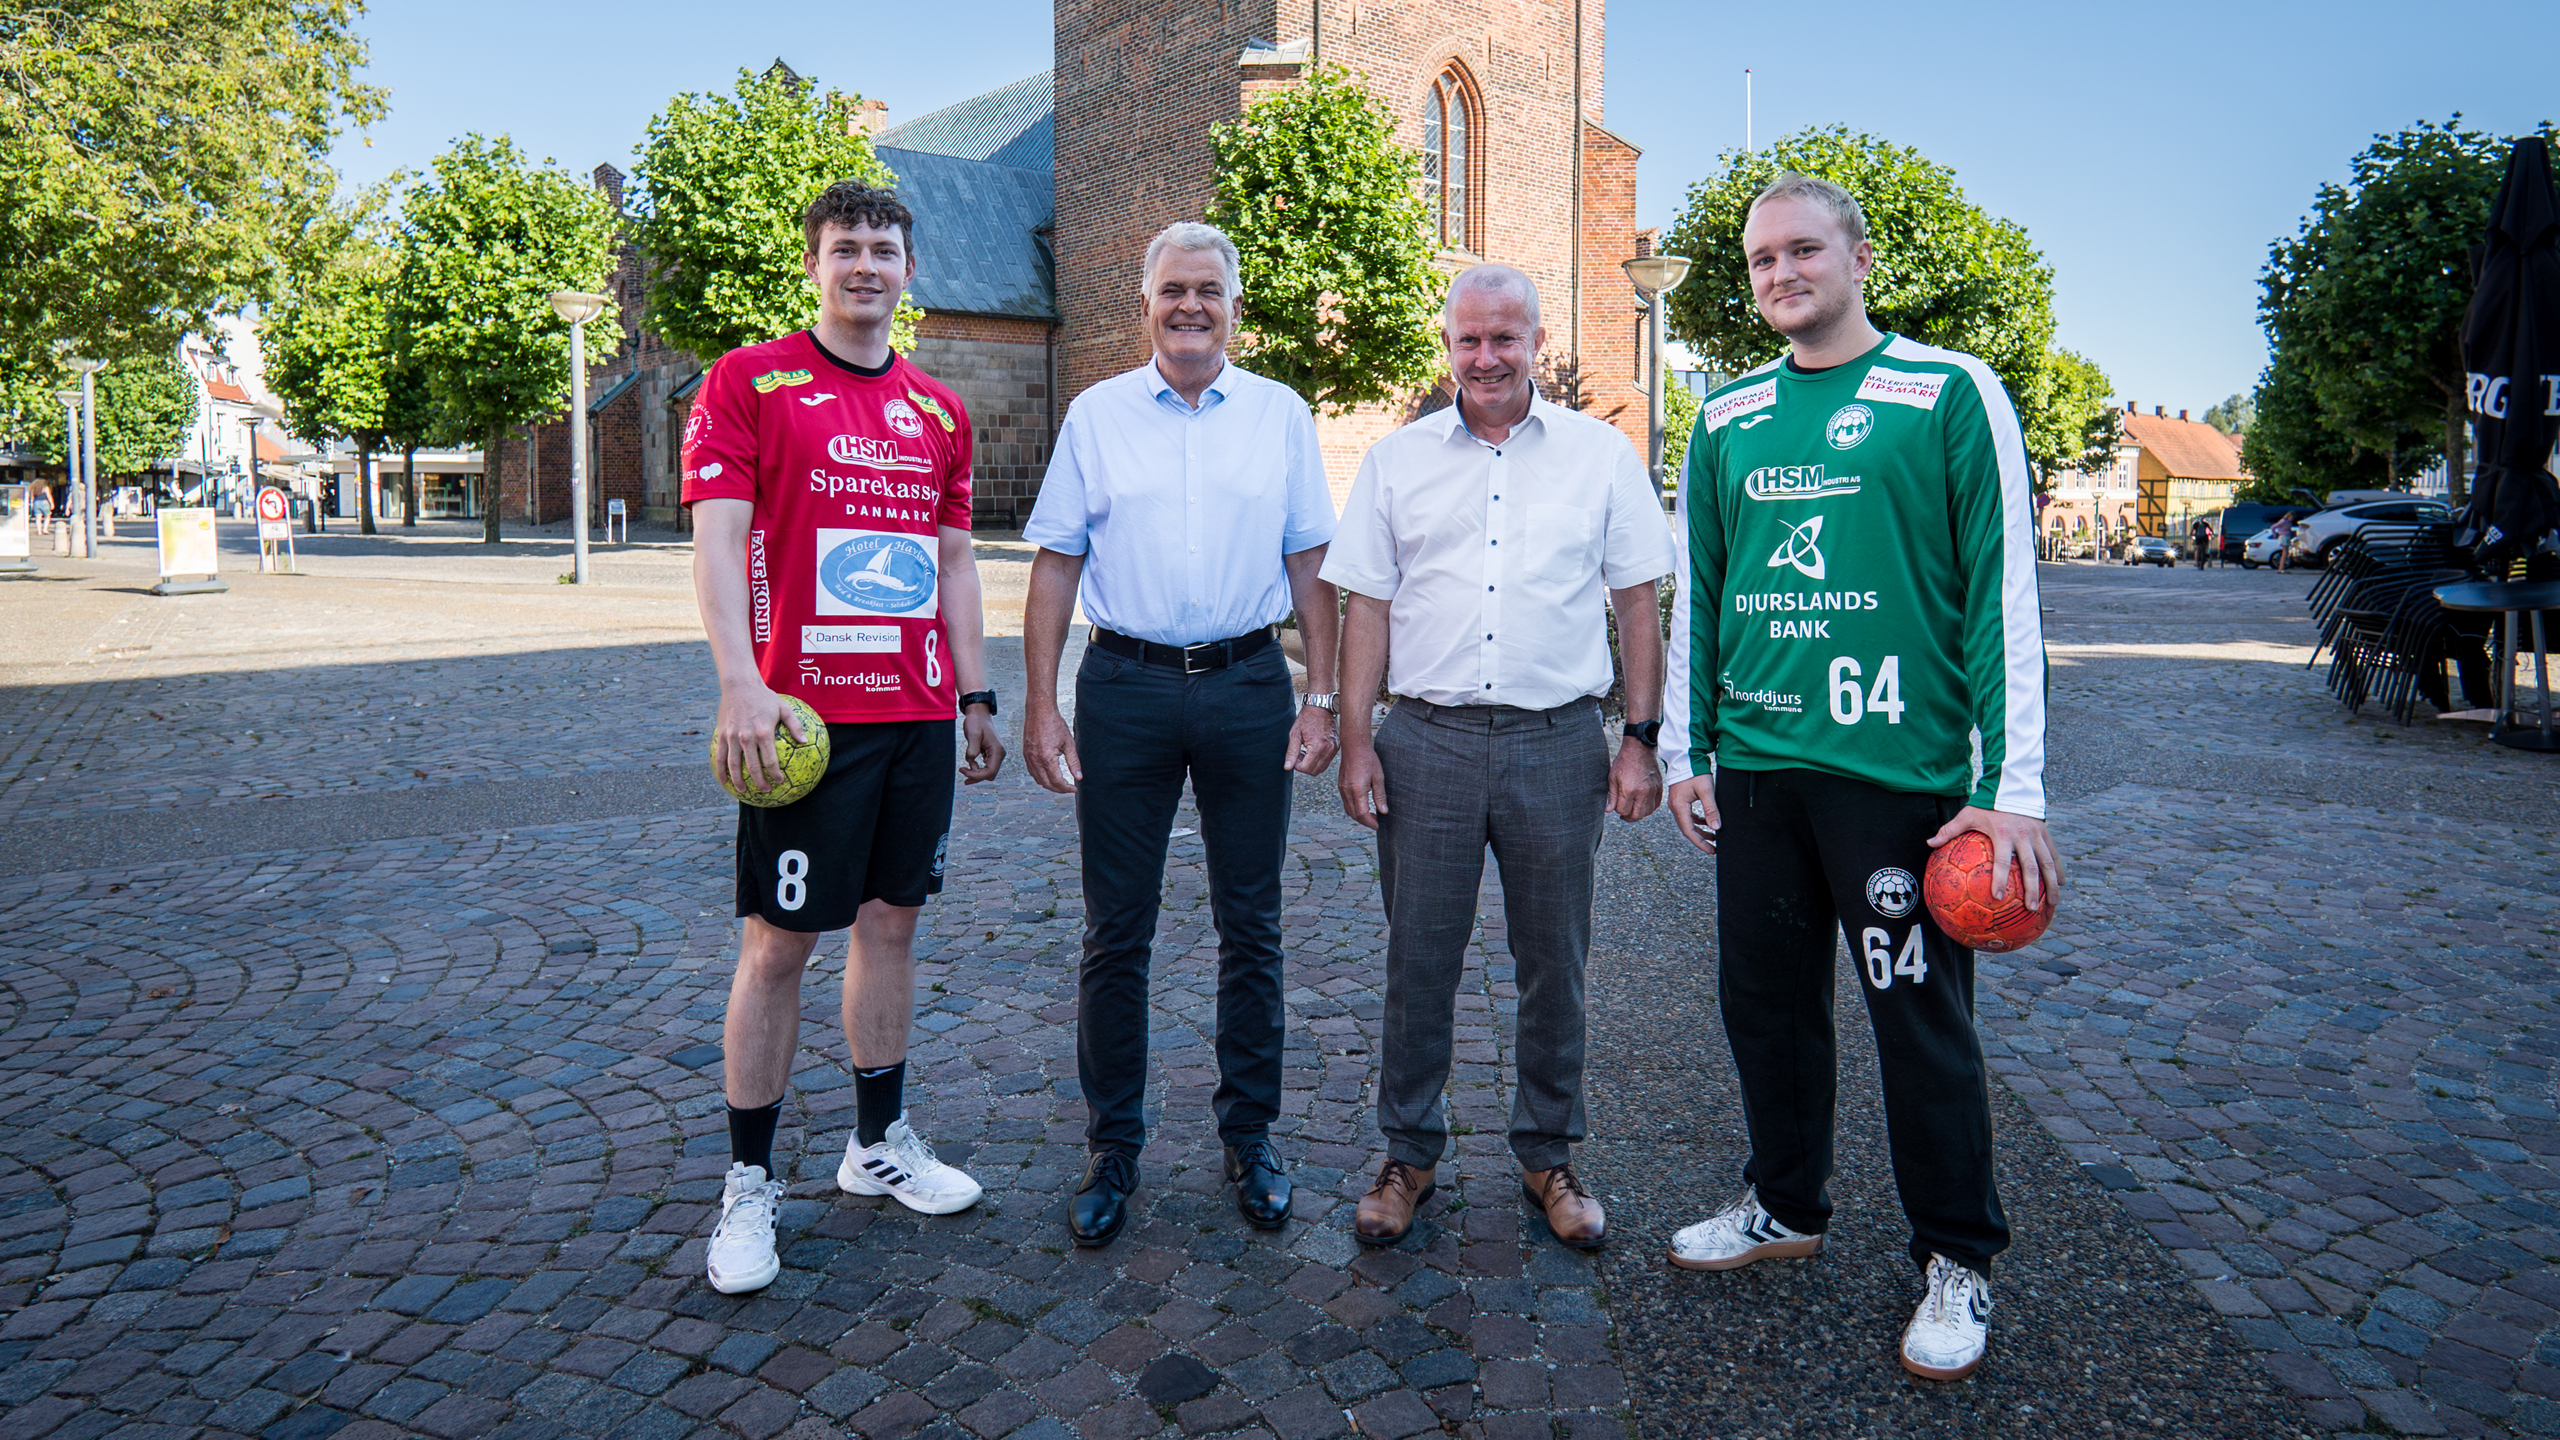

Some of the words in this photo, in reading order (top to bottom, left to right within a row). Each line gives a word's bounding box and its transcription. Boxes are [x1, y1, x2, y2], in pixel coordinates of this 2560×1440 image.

[1863, 381, 1939, 398] TIPSMARK
[1865, 375, 1941, 391] MALERFIRMAET
[1705, 385, 1774, 417] MALERFIRMAET
[1706, 390, 1775, 422] TIPSMARK
[843, 435, 899, 463] HSM
[898, 455, 922, 464] INDUSTRI
[1760, 464, 1824, 491] HSM
[1822, 476, 1849, 487] INDUSTRI
[1850, 475, 1861, 484] A/S
[846, 504, 930, 523] DANMARK
[751, 529, 767, 579] FAXE
[845, 537, 881, 556] Hotel
[894, 540, 934, 577] Havlund
[753, 580, 771, 643] KONDI
[853, 595, 884, 608] Breakfast
[1735, 591, 1878, 616] DJURSLANDS
[816, 632, 852, 642] Dansk
[857, 632, 900, 643] Revision
[1769, 620, 1831, 638] BANK
[925, 629, 941, 687] 8
[824, 672, 900, 688] norddjurs
[1828, 655, 1905, 725] 64
[1735, 689, 1802, 705] norddjurs
[1764, 704, 1802, 713] kommune
[777, 849, 809, 911] 8
[1882, 868, 1914, 885] HÅNDBOLD
[1862, 923, 1928, 989] 64
